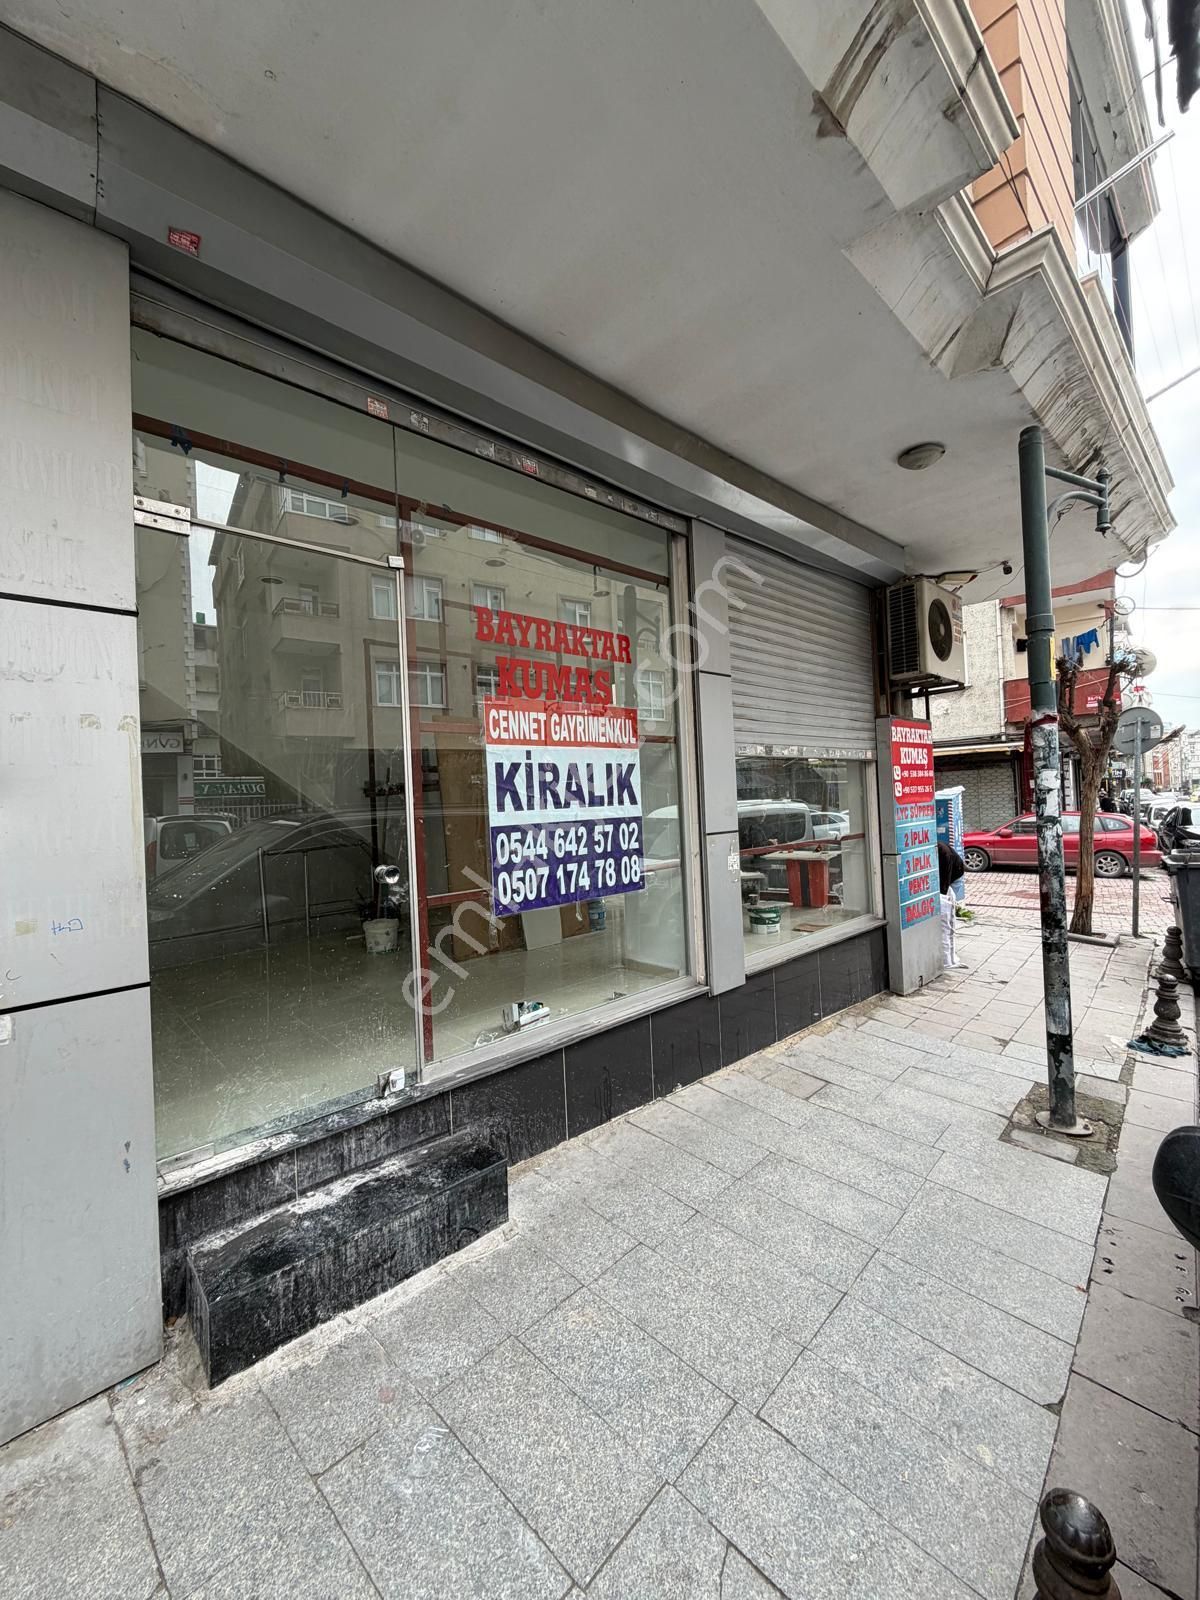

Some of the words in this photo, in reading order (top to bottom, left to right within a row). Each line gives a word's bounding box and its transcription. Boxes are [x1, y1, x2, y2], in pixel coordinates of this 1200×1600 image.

[474, 606, 632, 664] BAYRAKTAR
[489, 708, 547, 741] CENNET
[891, 726, 933, 744] BAYRAKTAR
[900, 747, 928, 769] KUMAŞ
[495, 750, 638, 812] KİRALIK
[496, 828, 548, 866] 0544
[554, 826, 588, 859] 642
[593, 824, 614, 853] 57
[619, 822, 640, 850] 02
[904, 832, 909, 847] 2
[910, 826, 930, 847] İPLİK
[905, 860, 911, 874] 3
[912, 851, 932, 873] İPLİK
[497, 866, 550, 906] 0507
[556, 861, 591, 894] 174
[595, 858, 617, 887] 78
[620, 854, 641, 884] 08
